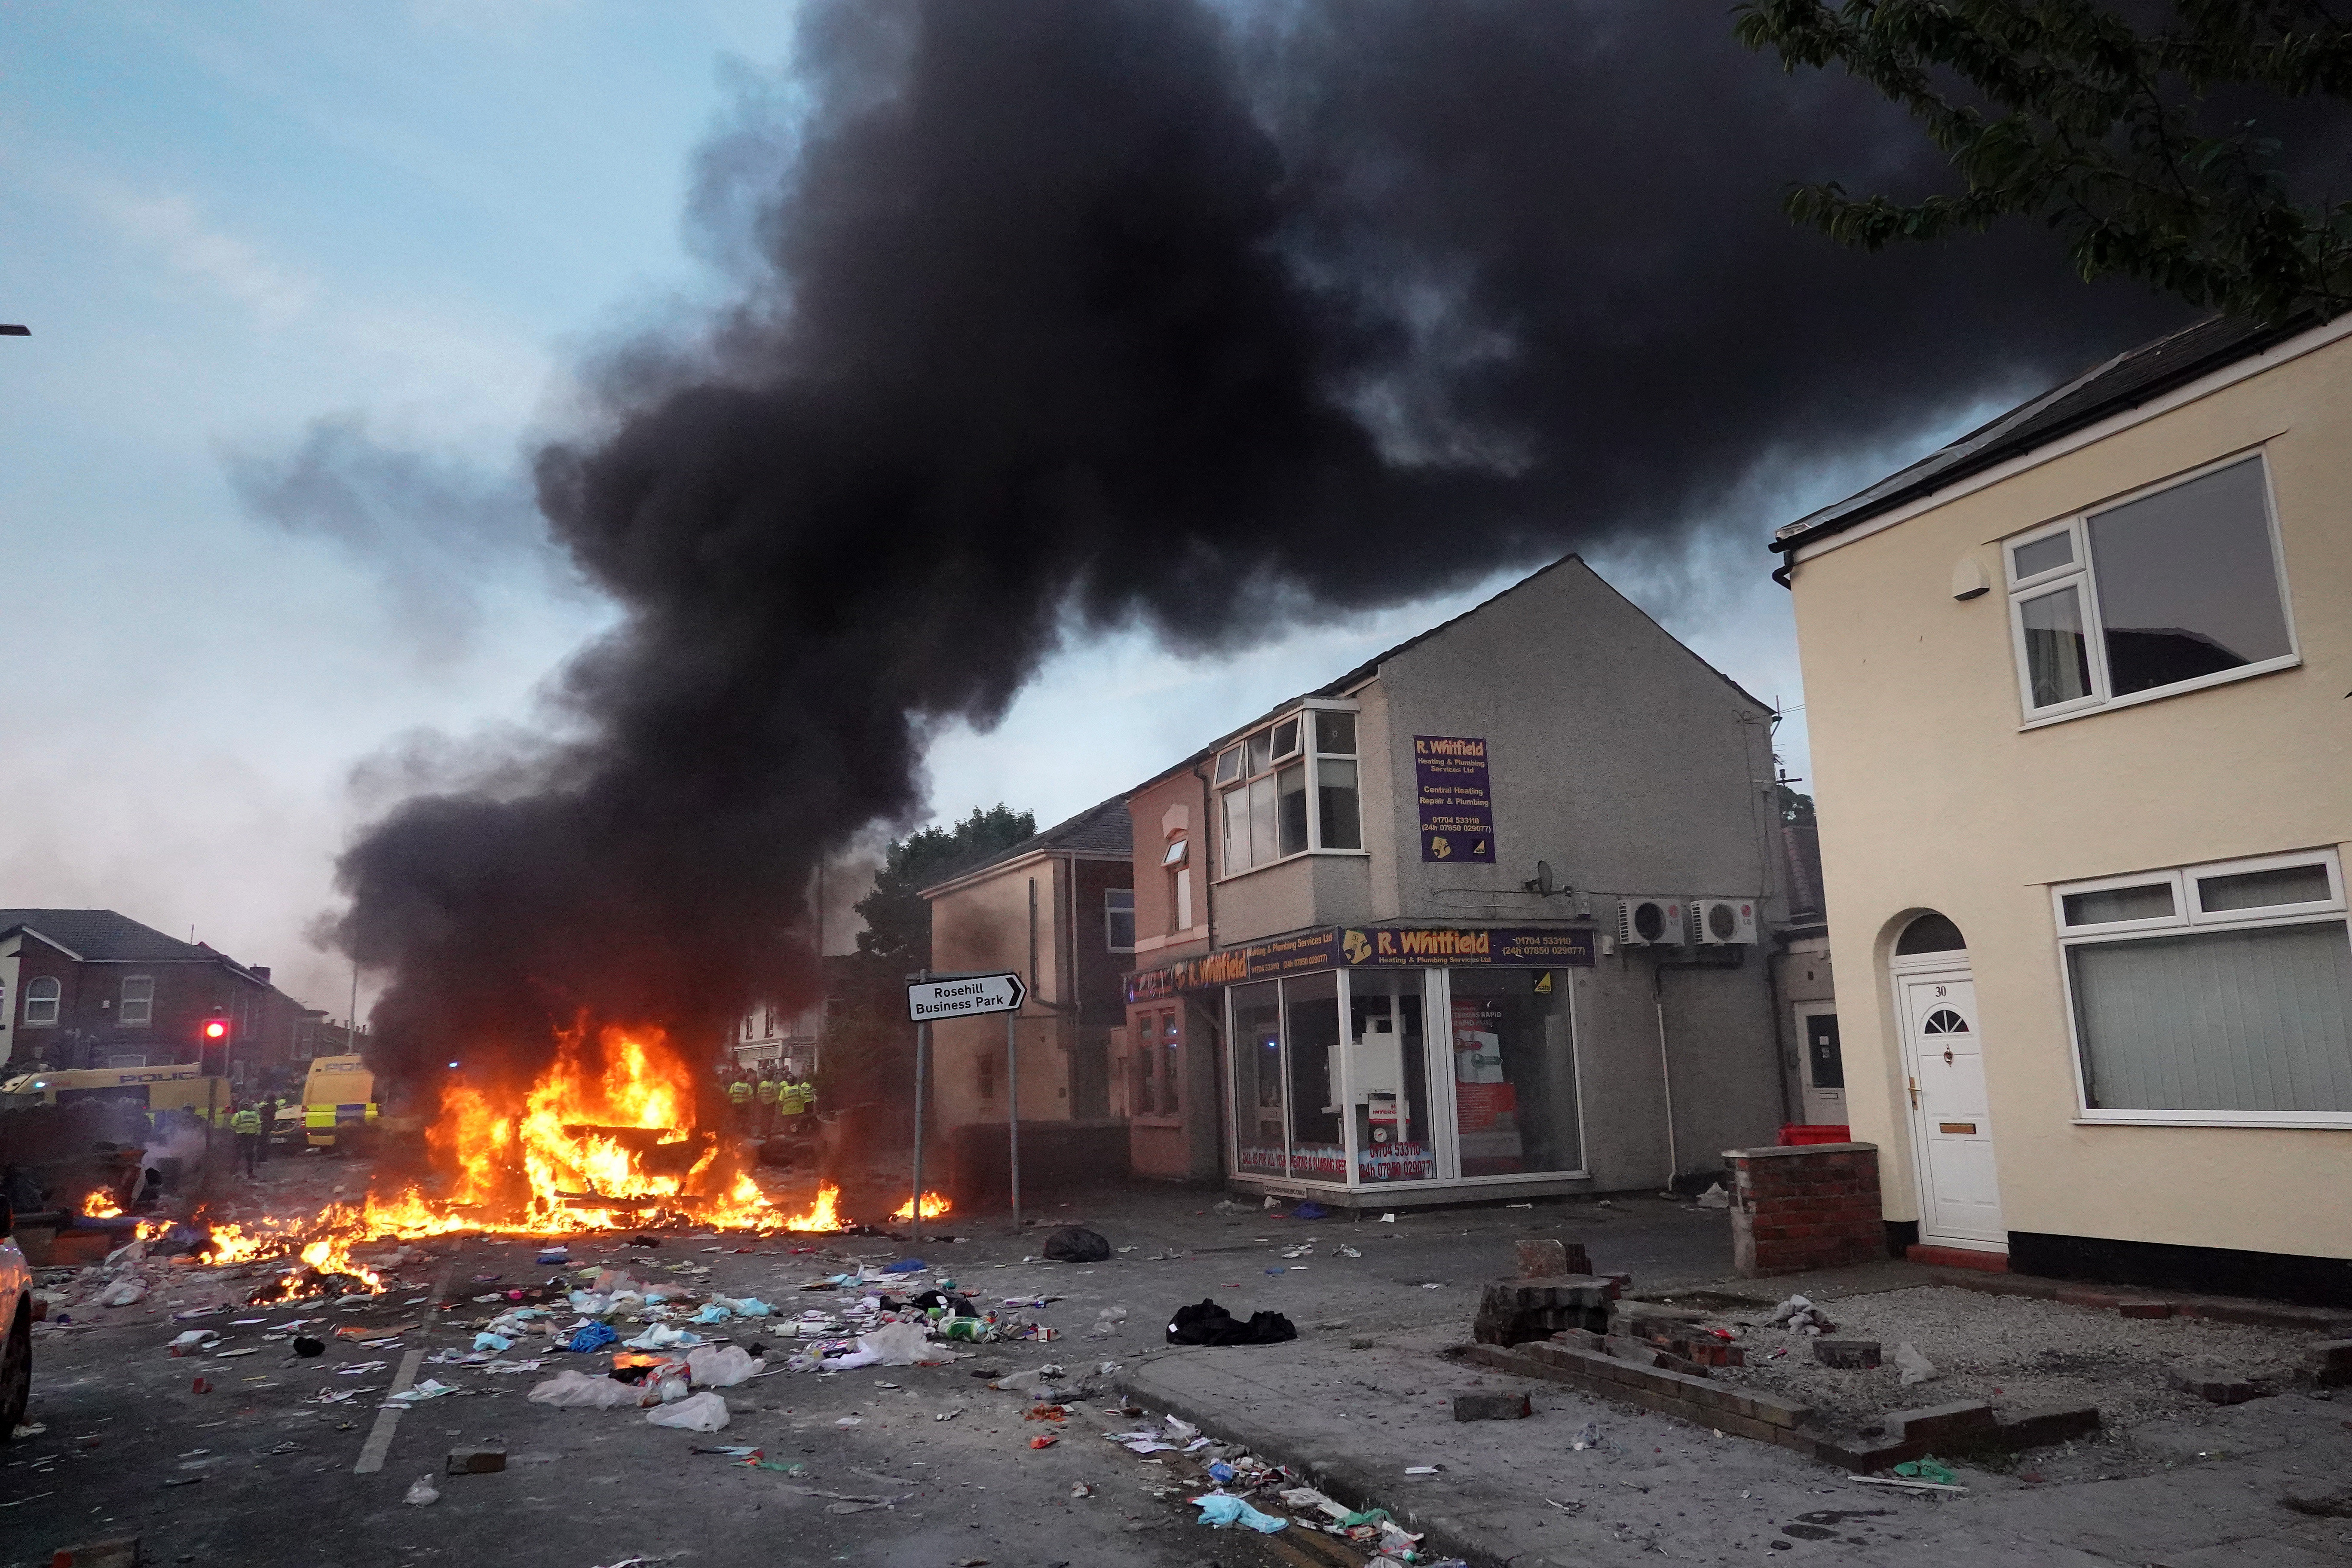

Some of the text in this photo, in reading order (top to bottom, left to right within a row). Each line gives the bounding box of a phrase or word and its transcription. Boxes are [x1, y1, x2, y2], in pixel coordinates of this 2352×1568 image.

[1416, 739, 1484, 756] R. Whitfield
[1418, 757, 1445, 766] Heating
[1454, 759, 1485, 768] Plumbing
[1454, 787, 1483, 796] Heating
[1420, 797, 1444, 805] Repair
[1455, 798, 1489, 807] Plumbing
[1422, 824, 1437, 832] (24h
[1250, 933, 1332, 957] eating & Plumbing Services Ltd
[1377, 930, 1490, 955] R. Whitfield
[1515, 937, 1571, 945] 01704 533110
[1503, 947, 1522, 956] (24h
[1552, 946, 1586, 956] 029077)
[1199, 949, 1246, 985] Whitfield
[934, 983, 984, 998] Rosehill
[1936, 986, 1947, 997] 30
[916, 994, 1004, 1014] Business Park
[1369, 1142, 1421, 1158] 01704 533110
[1378, 1161, 1401, 1177] 07850
[1404, 1160, 1434, 1178] 029077)
